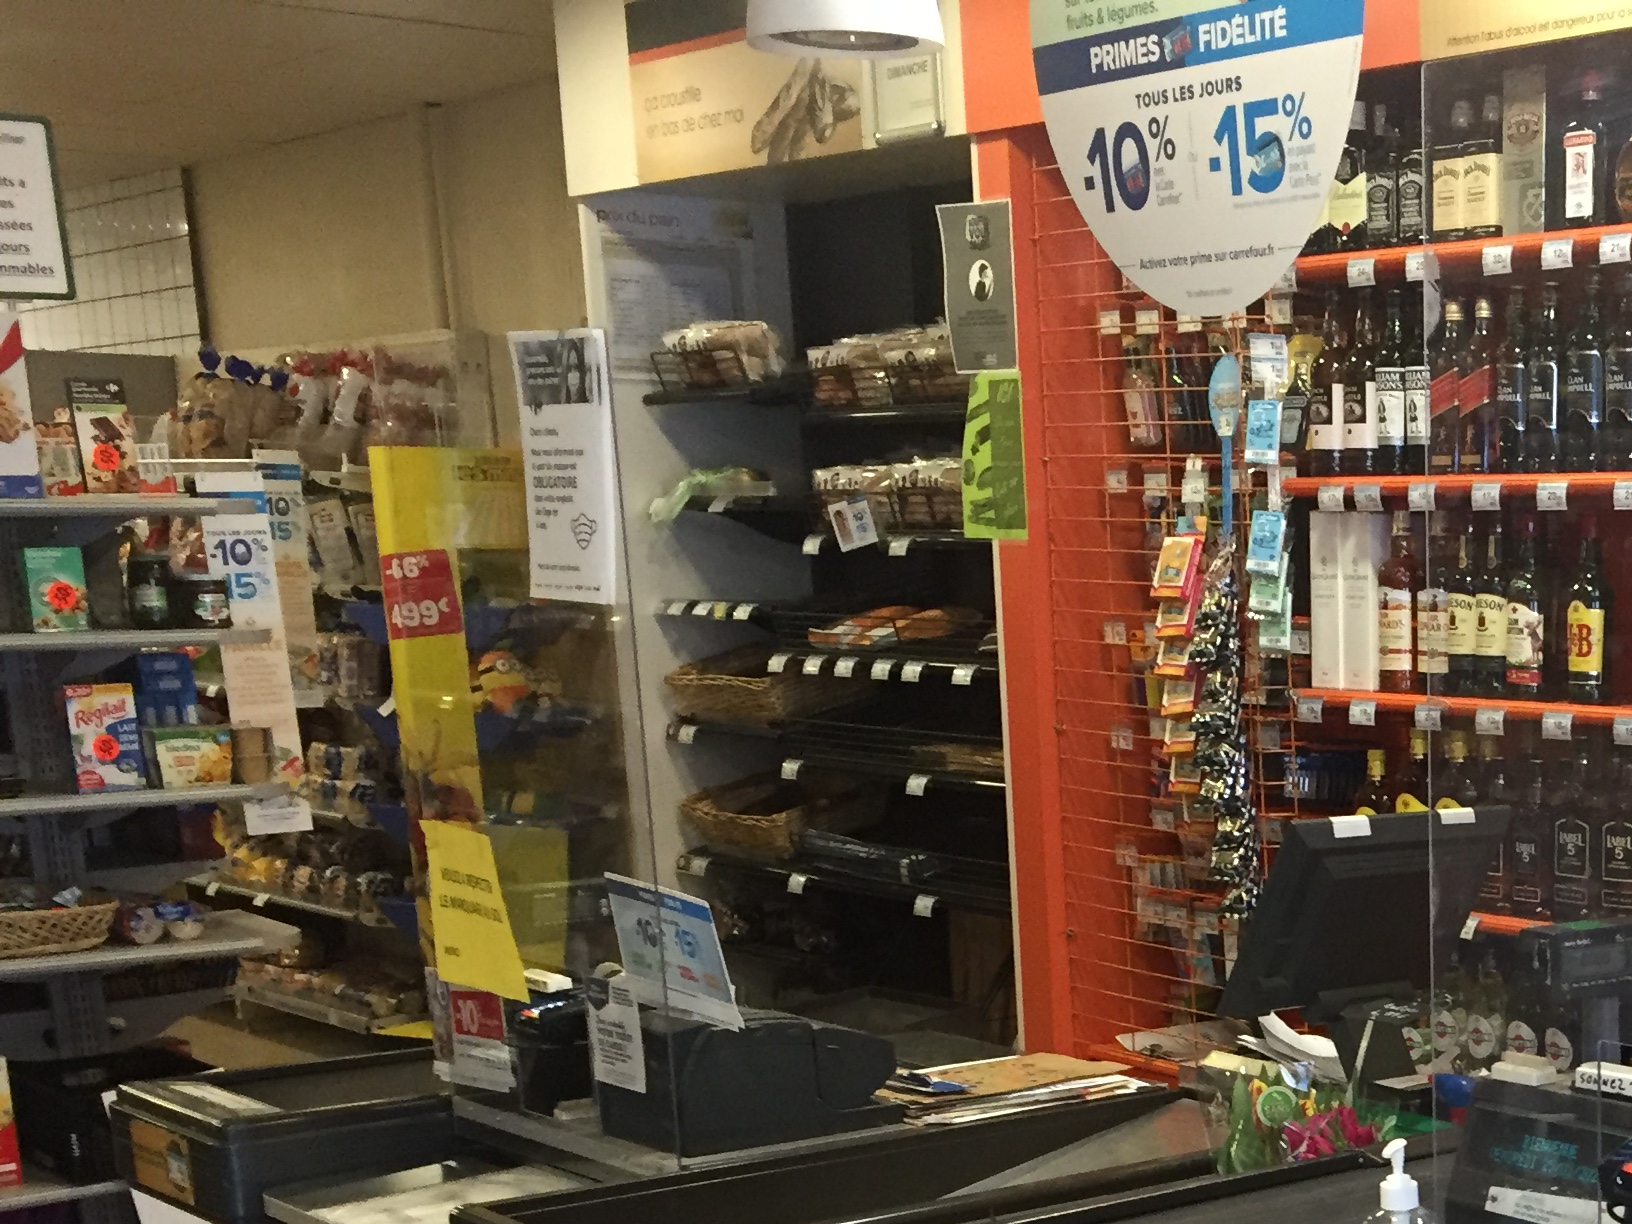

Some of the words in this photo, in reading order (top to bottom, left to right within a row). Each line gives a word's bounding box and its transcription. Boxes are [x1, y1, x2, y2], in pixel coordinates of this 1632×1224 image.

[1066, 13, 1094, 31] fruits
[1097, 9, 1105, 25] &
[1198, 6, 1287, 52] FIDÉLITÉ
[1090, 34, 1160, 73] PRIMES
[1135, 89, 1169, 109] TOUS
[1172, 84, 1195, 103] LES
[1199, 75, 1242, 98] JOURS
[1140, 256, 1167, 270] Activez
[1168, 253, 1188, 268] votre
[1190, 252, 1212, 268] prime
[1214, 252, 1228, 263] sur
[1229, 243, 1274, 261] carrefour.fr
[533, 475, 578, 489] OBLIGATOIRE
[1559, 831, 1585, 847] LABEL
[1607, 834, 1632, 849] LABEL
[1567, 846, 1575, 855] 5
[1615, 848, 1623, 860] 5
